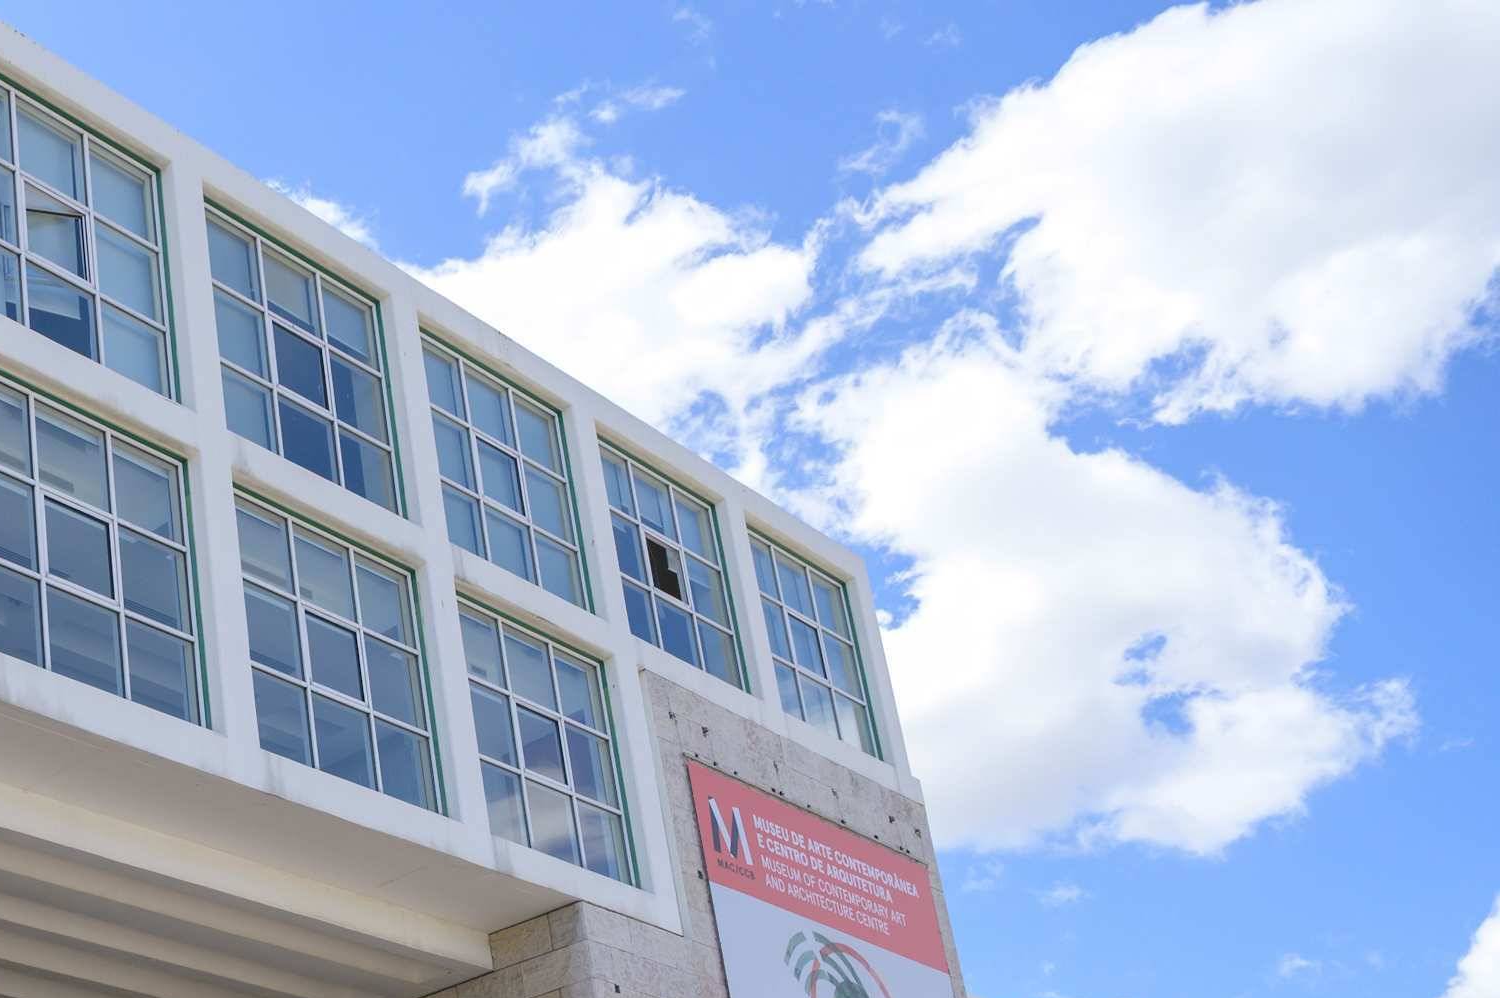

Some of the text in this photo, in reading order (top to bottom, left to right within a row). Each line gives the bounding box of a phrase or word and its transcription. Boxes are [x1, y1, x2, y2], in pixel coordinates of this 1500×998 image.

[753, 814, 919, 898] MUSEU DE ARTE CONTEMPORÂNEA
[757, 833, 893, 903] E CENTRO DE ARQUITETURA
[760, 854, 906, 926] MUSEUM OF CONTEMPORARY ART
[765, 874, 890, 935] AND ARCHITECTURE CENTRE
